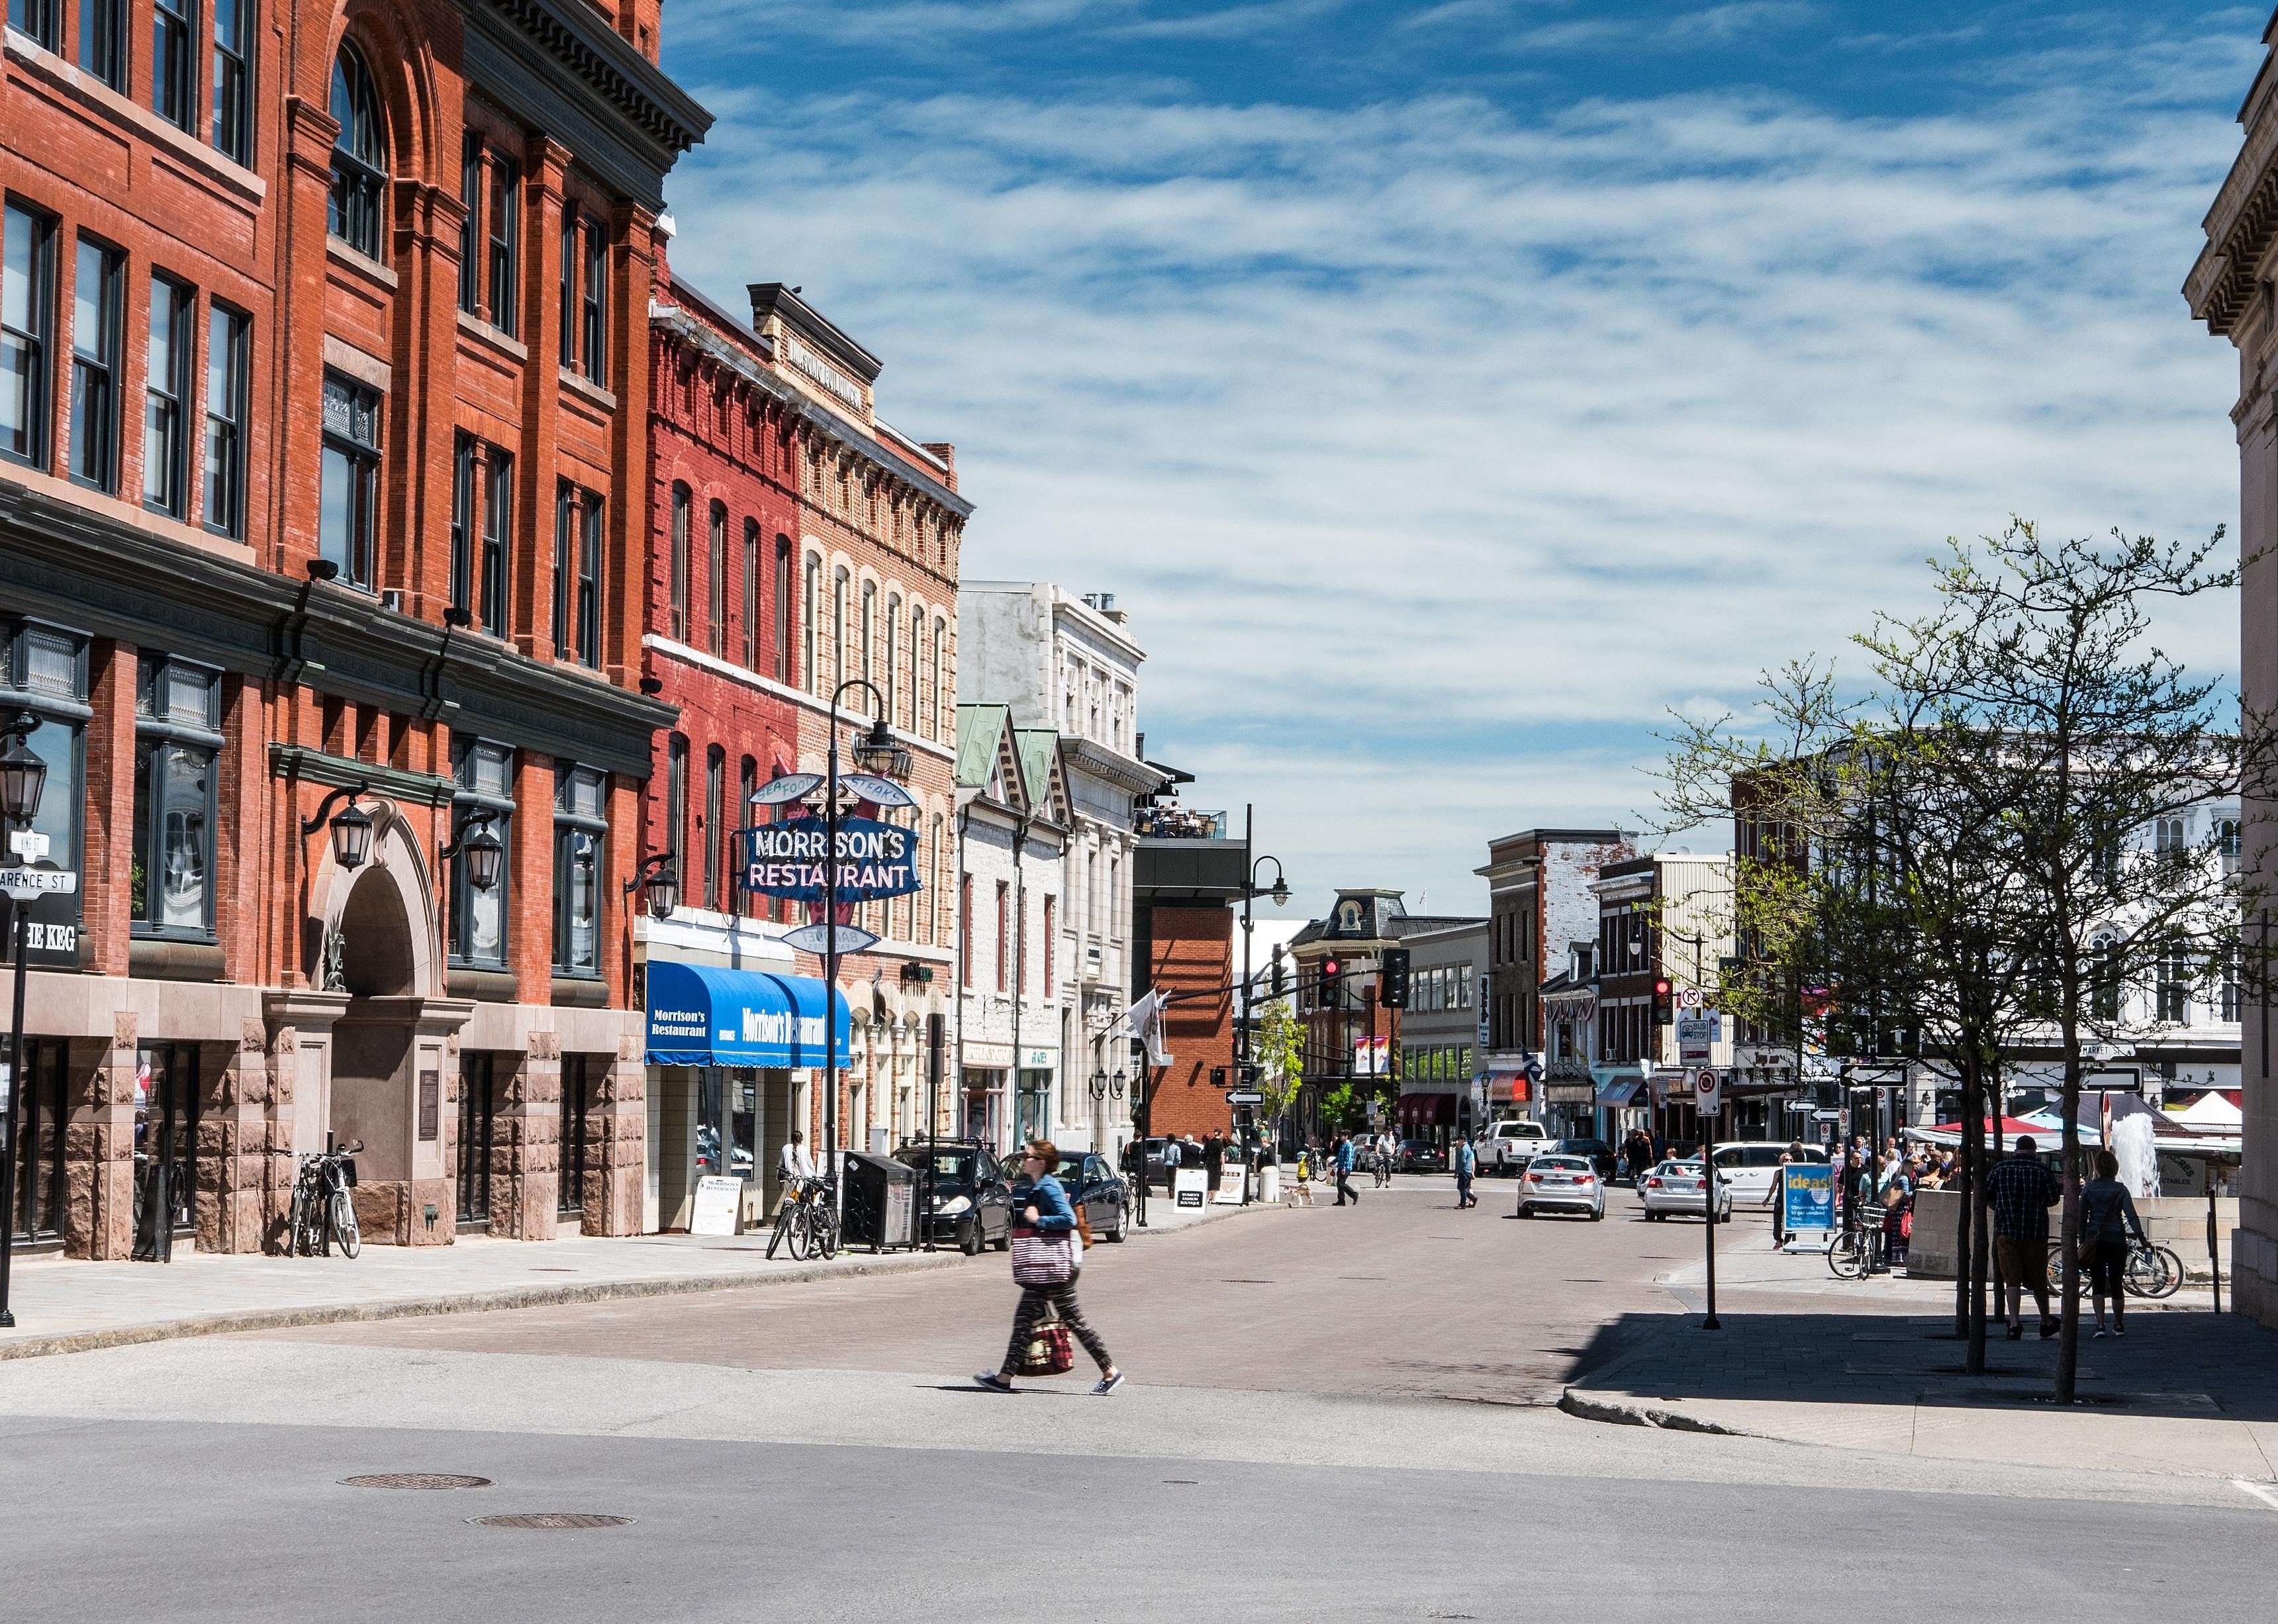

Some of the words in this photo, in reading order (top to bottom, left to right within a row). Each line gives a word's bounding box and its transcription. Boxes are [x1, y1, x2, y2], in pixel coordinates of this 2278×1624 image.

[756, 776, 814, 802] SEAFOOD
[851, 778, 900, 802] STEAKS
[755, 829, 905, 859] MORRSON'S
[0, 872, 43, 888] ARENCE
[52, 875, 66, 890] ST
[14, 921, 44, 949] HE
[46, 924, 75, 952] KEG
[654, 1009, 706, 1024] Morrison's
[742, 1007, 784, 1044] Morrison's
[784, 1011, 826, 1045] Restaurant
[651, 1024, 706, 1037] Restaurant
[1788, 1172, 1832, 1190] ideas!
